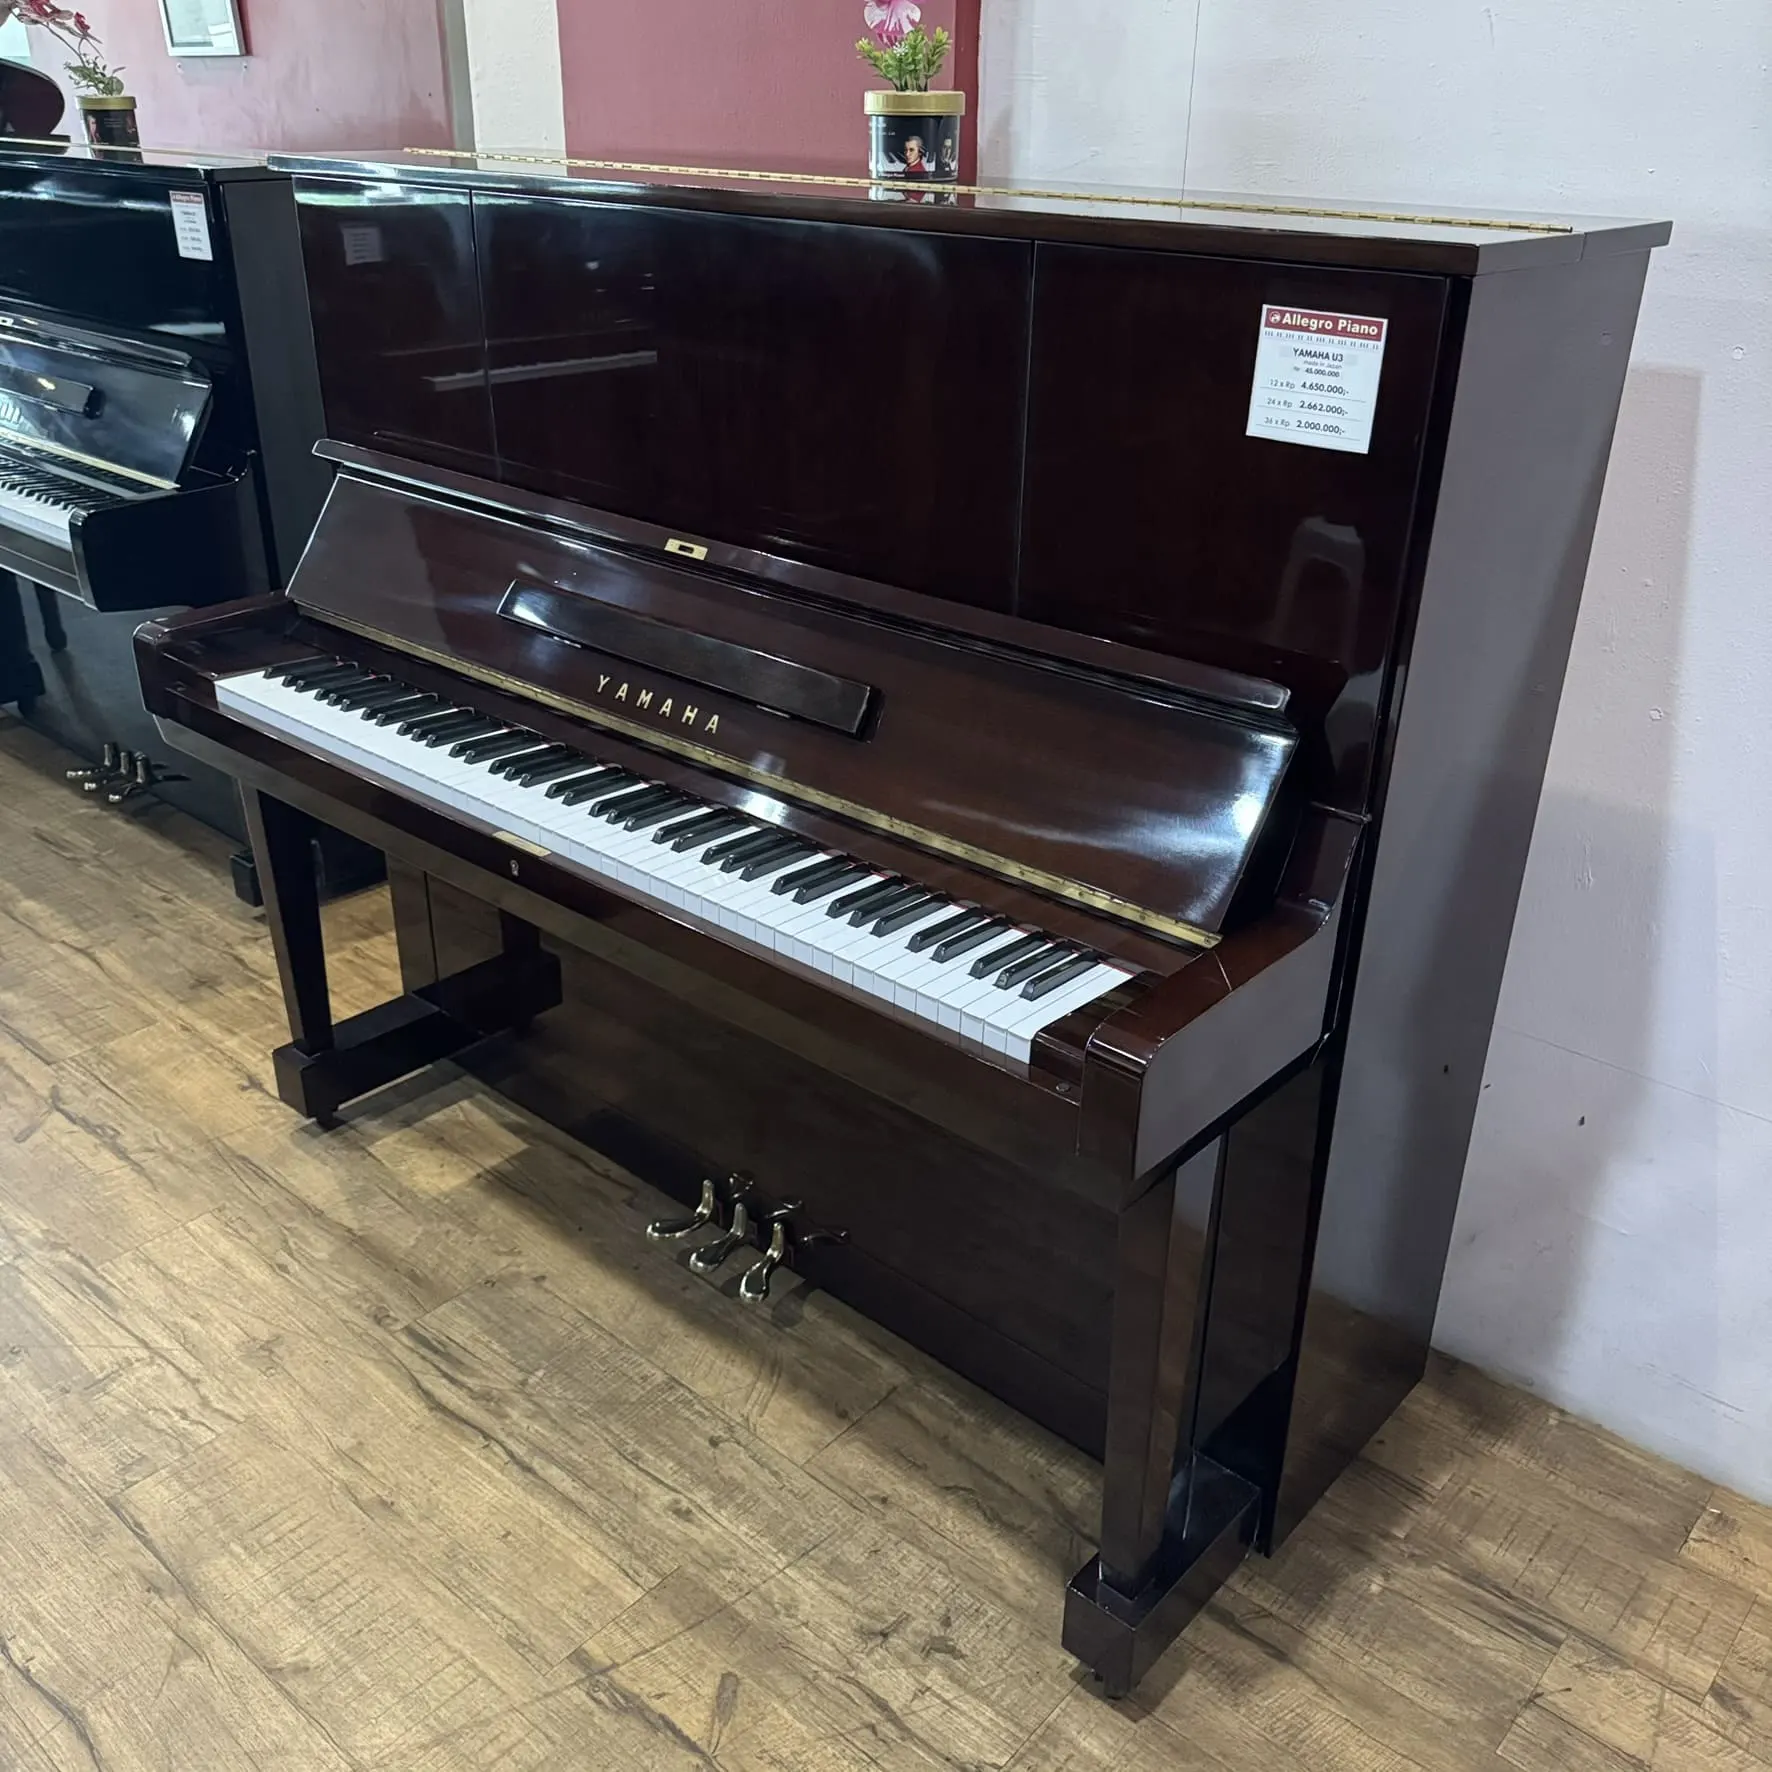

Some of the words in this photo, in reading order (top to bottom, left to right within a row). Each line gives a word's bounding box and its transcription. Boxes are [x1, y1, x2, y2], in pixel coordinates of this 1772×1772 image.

[1282, 313, 1333, 331] Allegro
[1337, 319, 1378, 335] Piano
[1293, 347, 1330, 360] YAMAHA
[1332, 353, 1344, 362] U3
[1270, 378, 1278, 387] 12
[1285, 381, 1295, 390] Rp
[1301, 381, 1349, 396] 4.650.000;-
[1267, 397, 1275, 406] 24
[1283, 400, 1293, 408] Rp
[1299, 400, 1348, 416] 2.662.000;-
[1264, 416, 1273, 425] 36
[1280, 419, 1290, 427] Rp
[1296, 419, 1346, 435] 2.000.000;-
[597, 674, 720, 734] YAMAHA
